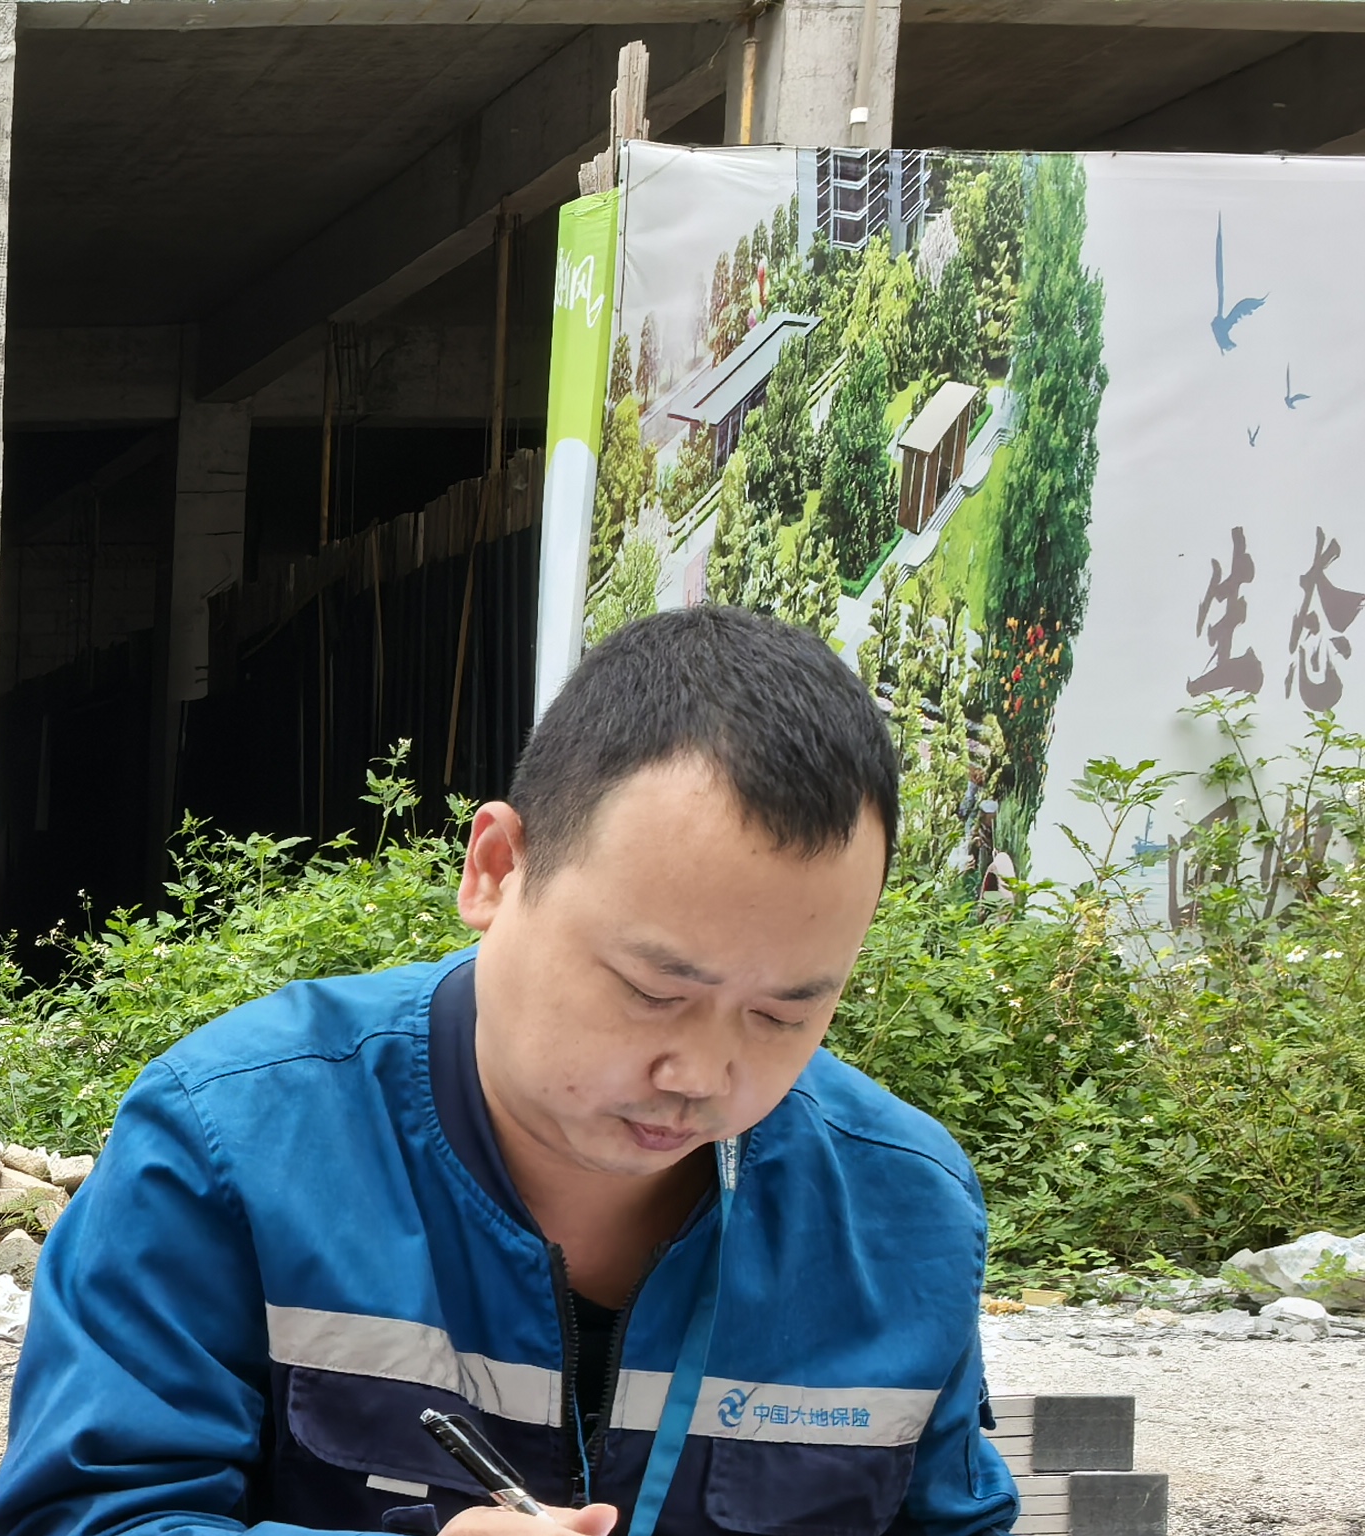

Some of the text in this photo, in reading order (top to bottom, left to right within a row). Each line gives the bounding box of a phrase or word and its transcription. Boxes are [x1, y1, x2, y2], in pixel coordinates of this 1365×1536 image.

[1186, 526, 1365, 711] 生态
[752, 1403, 871, 1428] 中国大地保险
